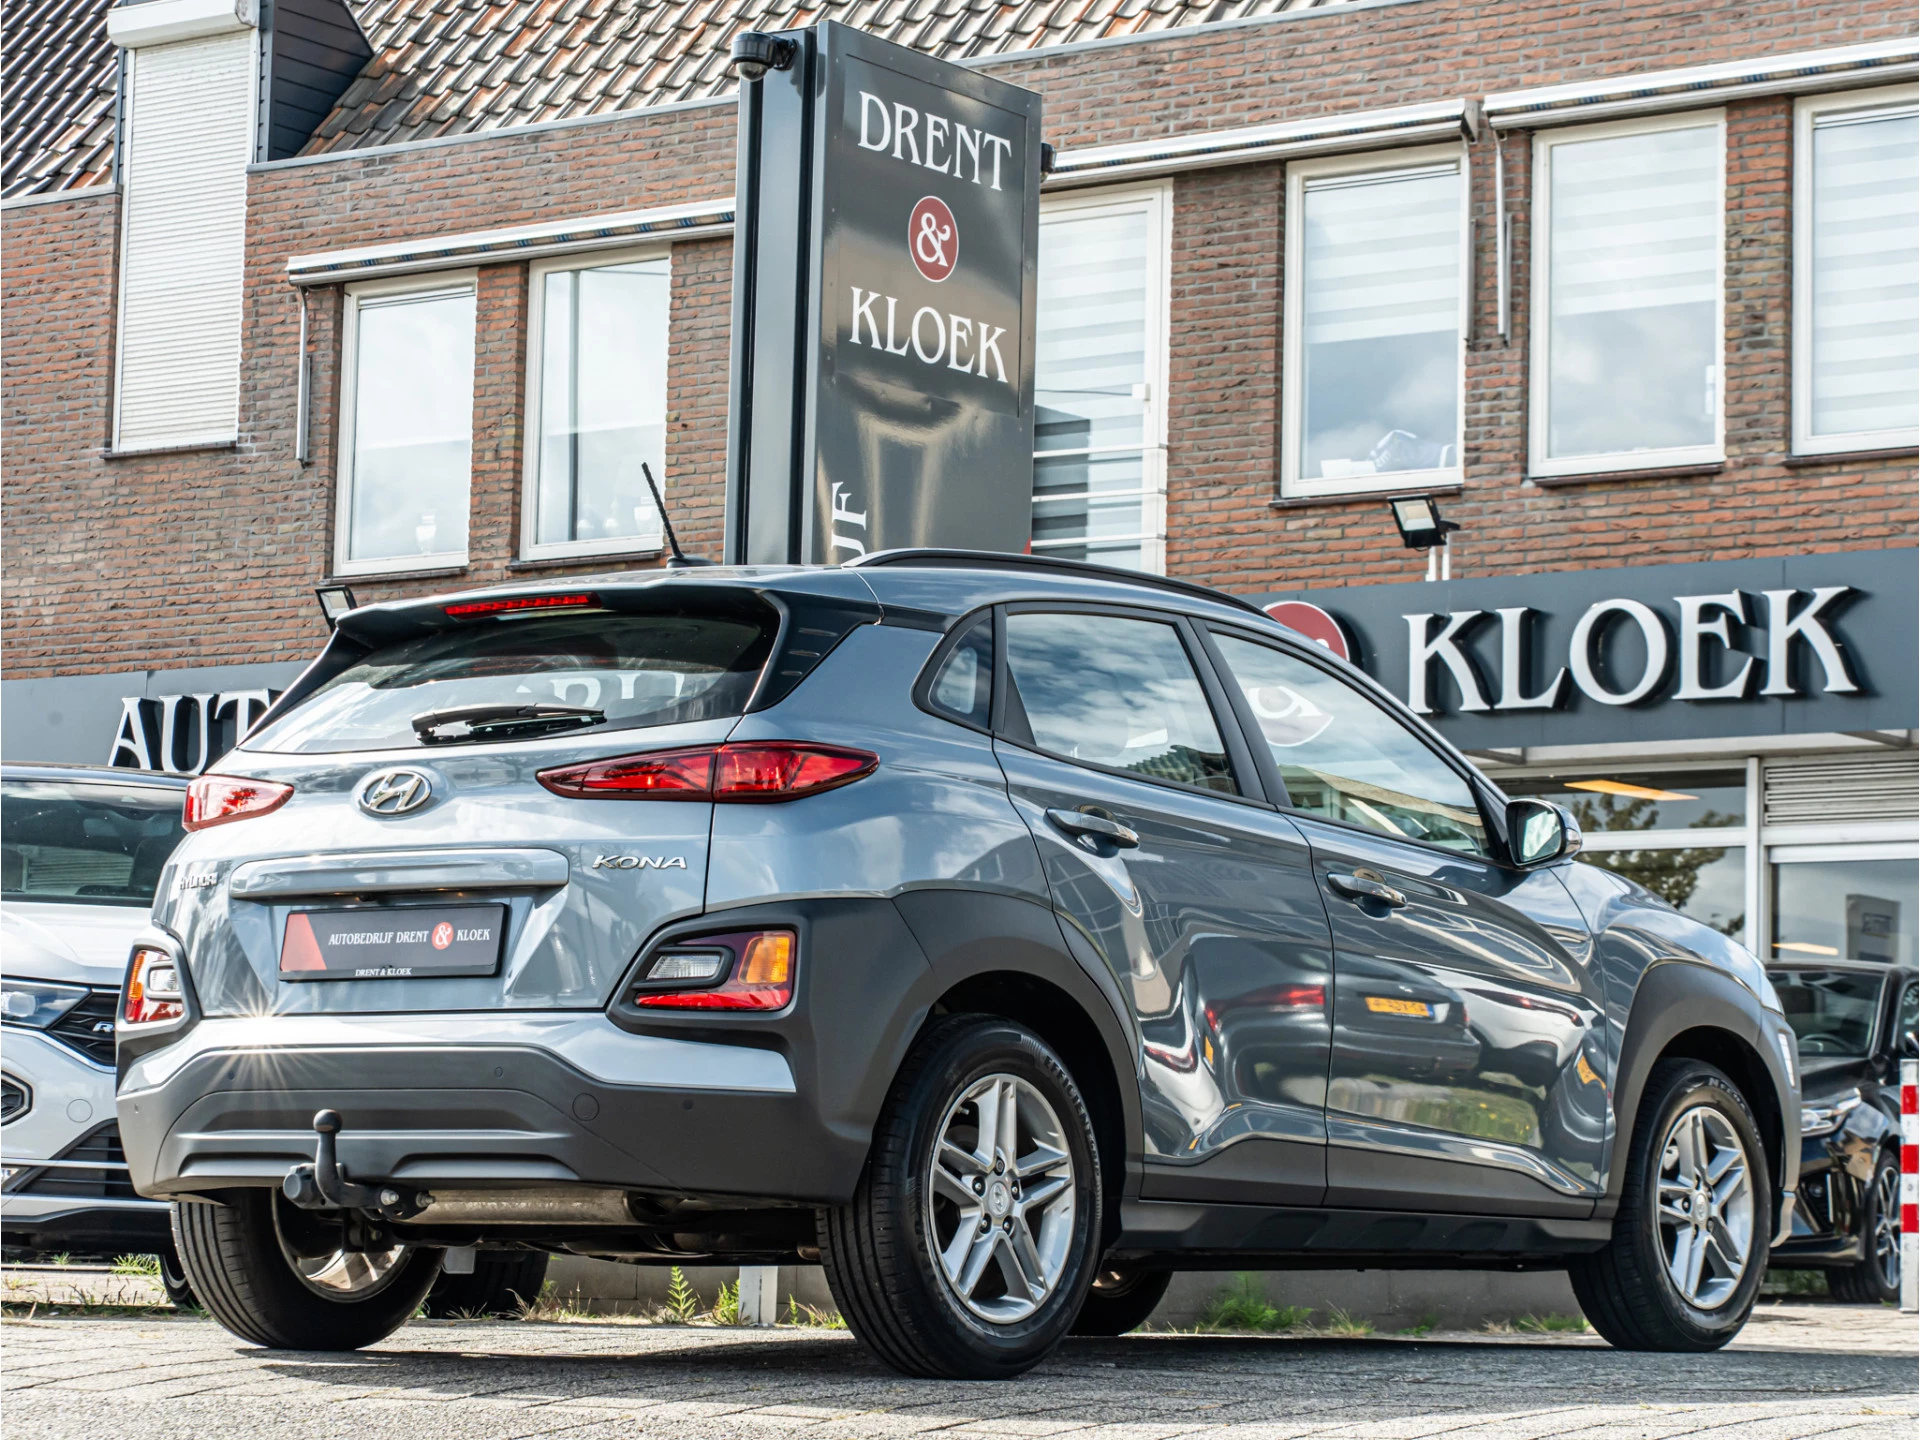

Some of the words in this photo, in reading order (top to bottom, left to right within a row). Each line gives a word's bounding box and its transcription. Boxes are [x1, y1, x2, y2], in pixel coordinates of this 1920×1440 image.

[857, 90, 1012, 192] DRENT
[916, 212, 951, 268] &
[848, 286, 1008, 384] KLOEK
[1401, 585, 1859, 715] KLOEK
[592, 855, 687, 869] KONA
[328, 931, 394, 945] AUTOBEDRIJF
[395, 930, 429, 944] DRENT
[434, 925, 451, 946] &
[456, 928, 491, 941] KLOEK
[387, 967, 412, 976] KLOEK
